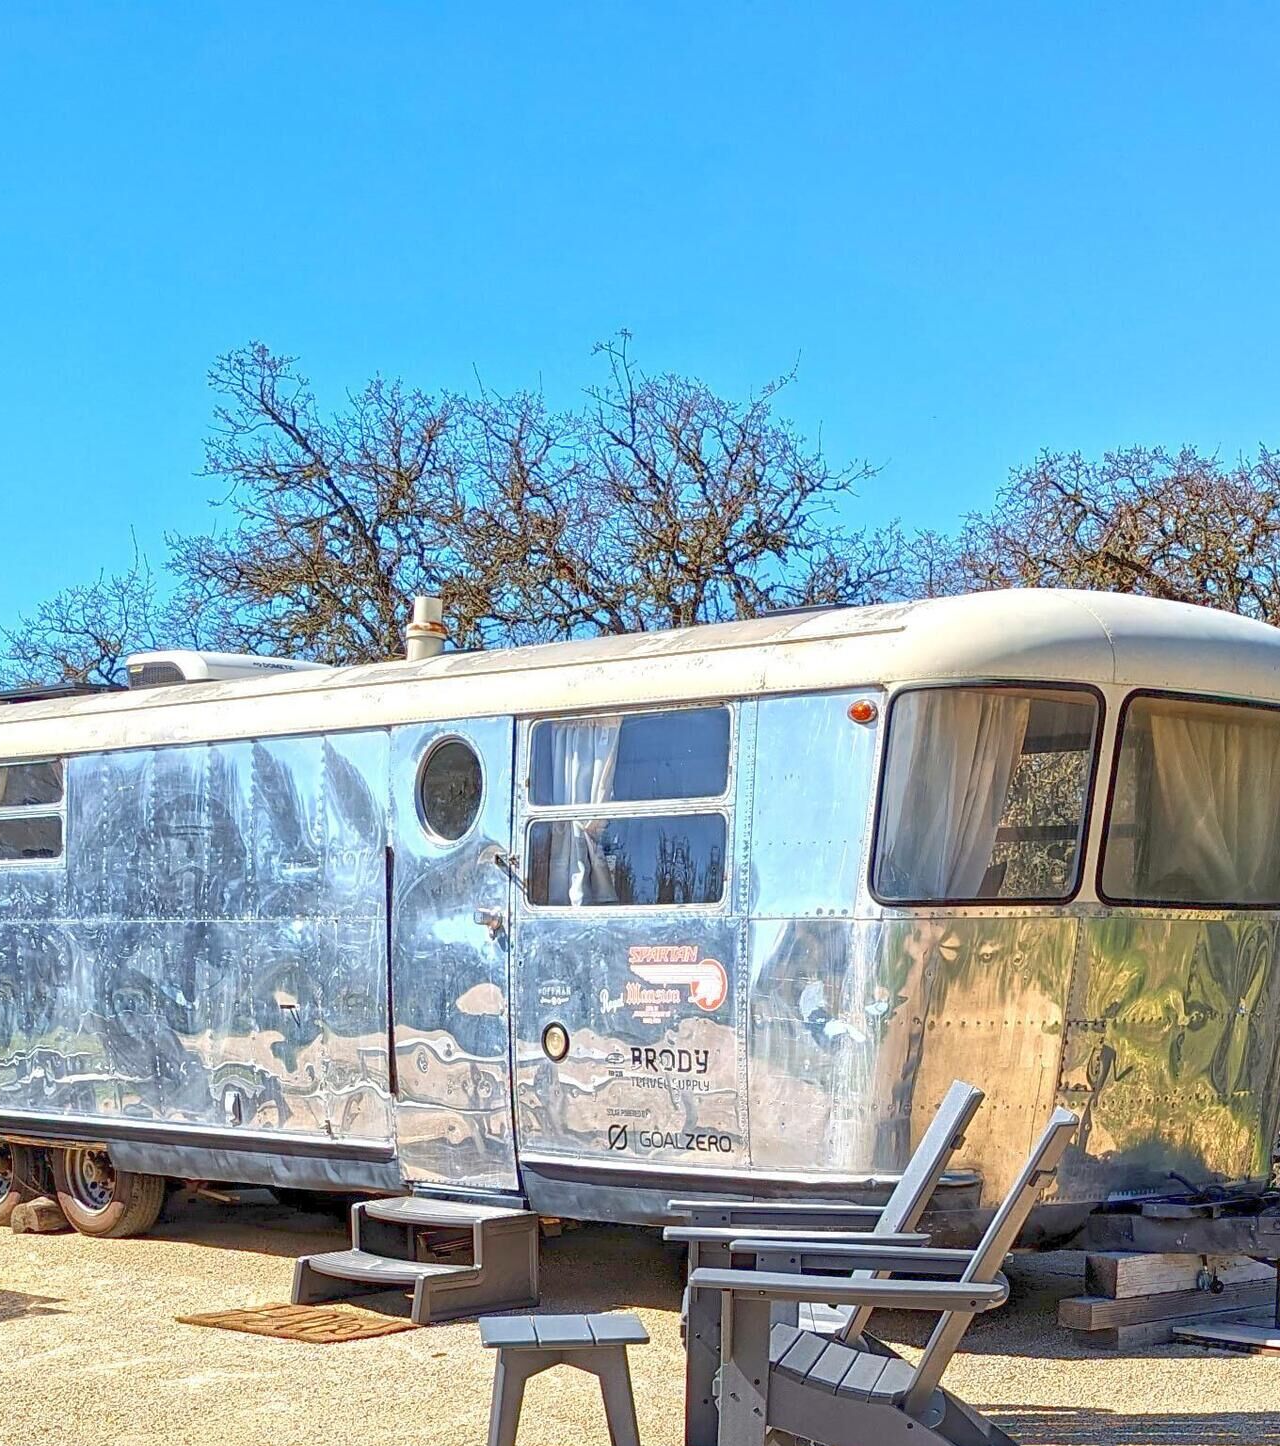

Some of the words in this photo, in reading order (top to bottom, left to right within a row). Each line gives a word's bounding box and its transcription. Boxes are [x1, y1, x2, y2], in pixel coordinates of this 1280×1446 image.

[629, 946, 698, 963] SPARTAN
[626, 982, 681, 1004] Mansion
[631, 1048, 709, 1074] BRODY
[631, 1077, 669, 1089] TRAVEL
[671, 1079, 710, 1092] SUPPLY
